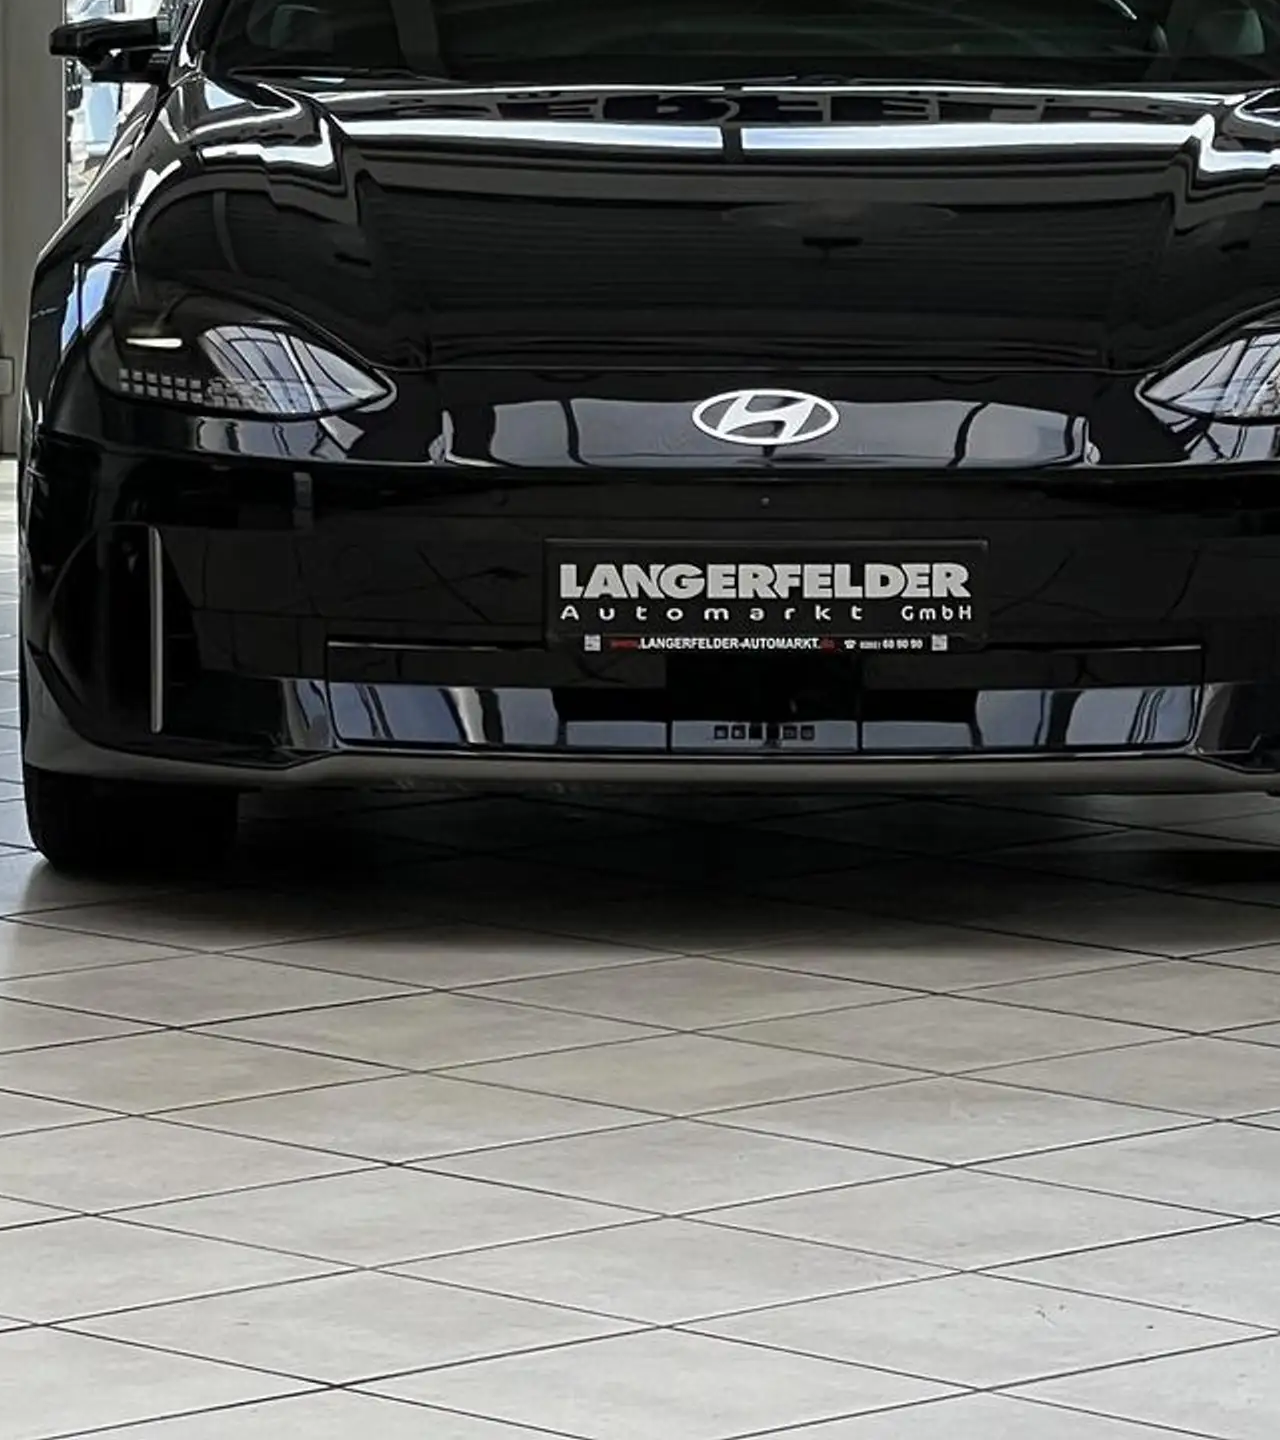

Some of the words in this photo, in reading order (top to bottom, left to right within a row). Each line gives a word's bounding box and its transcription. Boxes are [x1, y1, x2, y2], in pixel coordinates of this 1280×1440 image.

[560, 562, 972, 599] LANGERFELDER
[560, 604, 863, 622] Automarkt
[900, 604, 972, 622] GmbH
[609, 636, 836, 651] .LANGERFELDER-AUTOMARKT.
